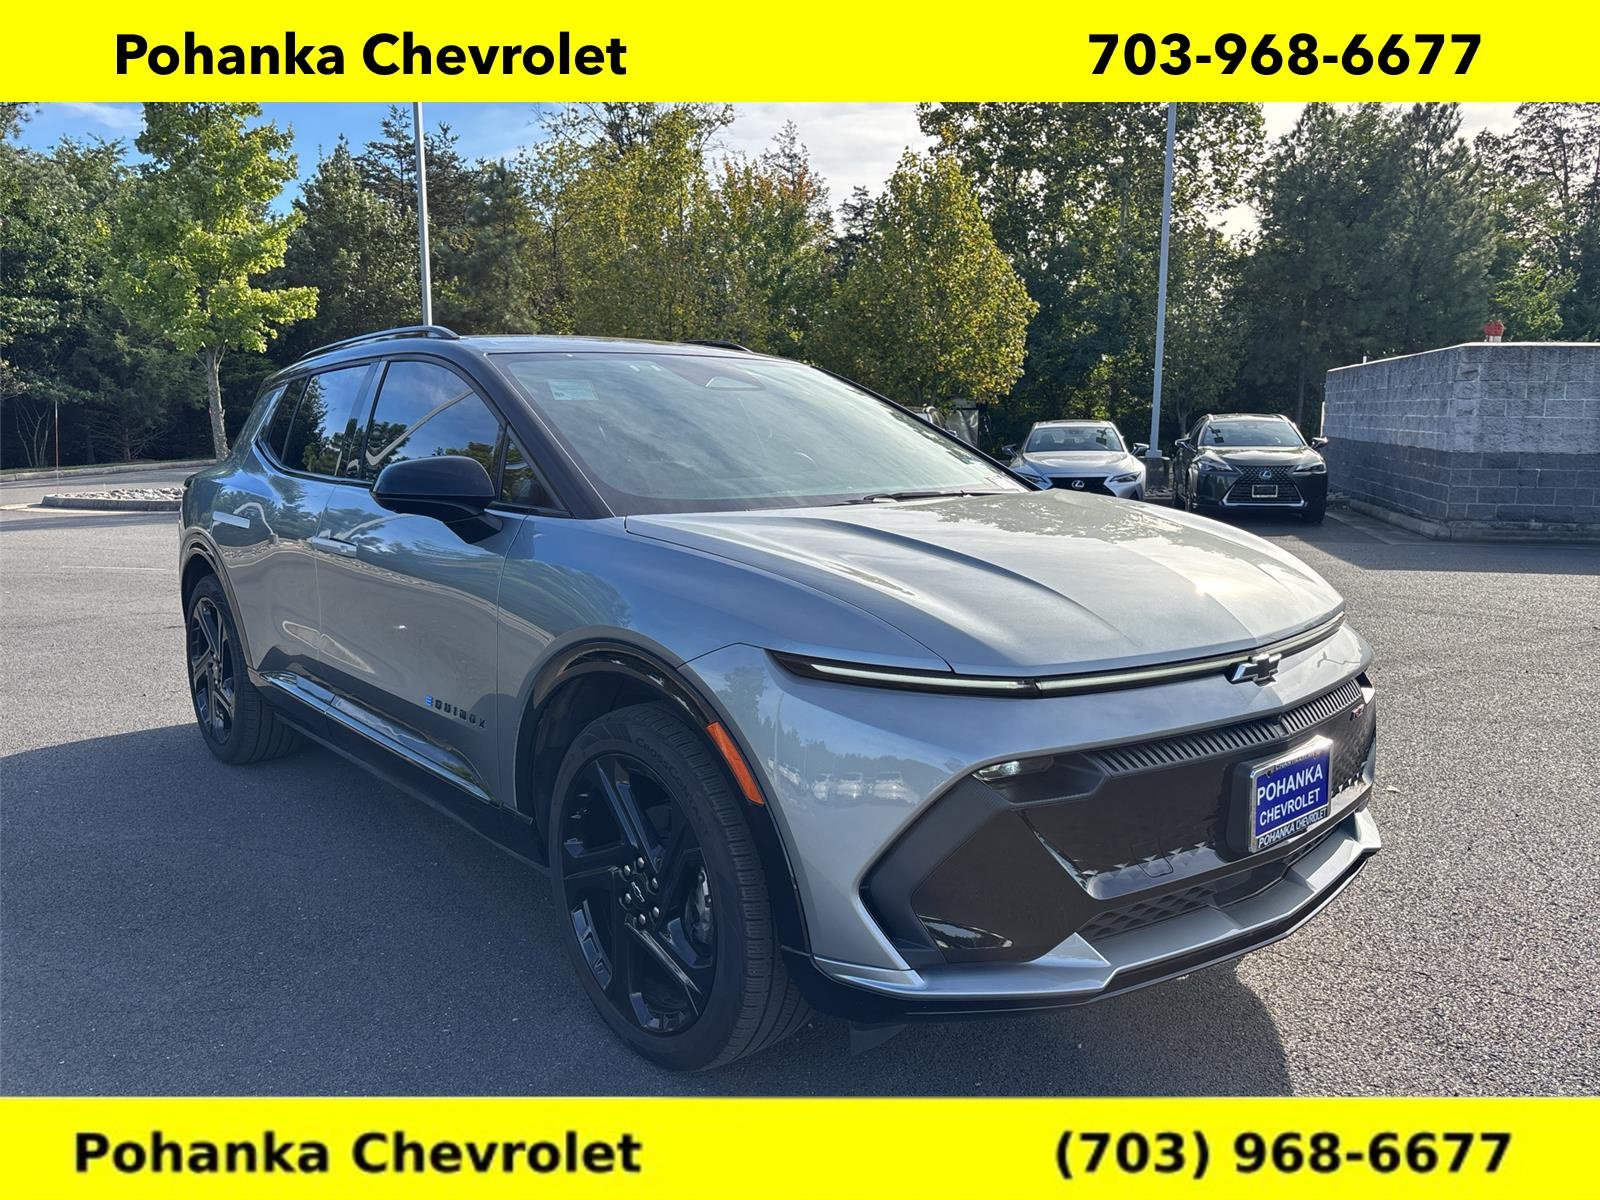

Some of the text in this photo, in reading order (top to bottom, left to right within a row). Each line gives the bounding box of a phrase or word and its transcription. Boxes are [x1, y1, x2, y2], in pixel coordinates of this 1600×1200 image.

[425, 694, 488, 729] EQUINOX
[1257, 763, 1323, 806] POHANKA
[1258, 807, 1328, 848] POHANKA CHEVROLET
[1259, 788, 1321, 827] CHEVROLET
